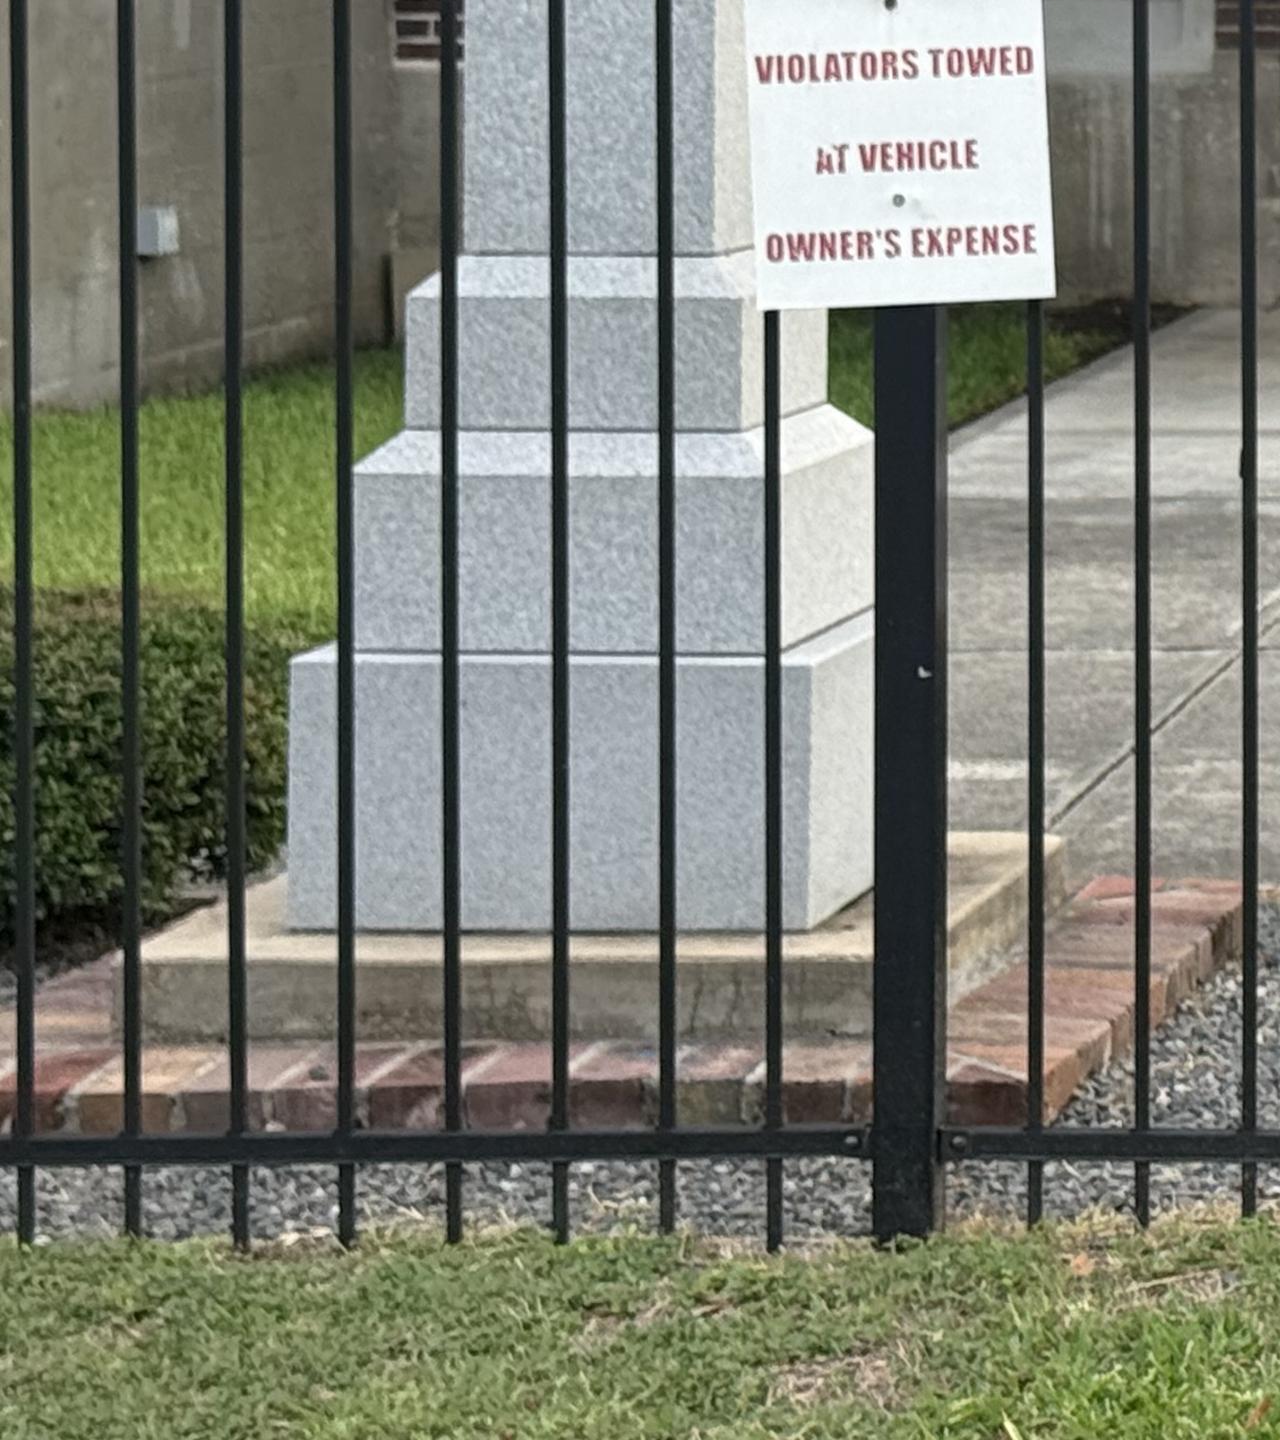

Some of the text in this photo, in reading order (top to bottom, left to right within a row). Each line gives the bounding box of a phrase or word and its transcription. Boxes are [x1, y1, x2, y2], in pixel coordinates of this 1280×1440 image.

[755, 45, 1034, 85] VIOLATORS TOWED
[815, 140, 980, 175] AT VEHICLE
[765, 224, 1037, 264] OWNER'S EXPENSE
